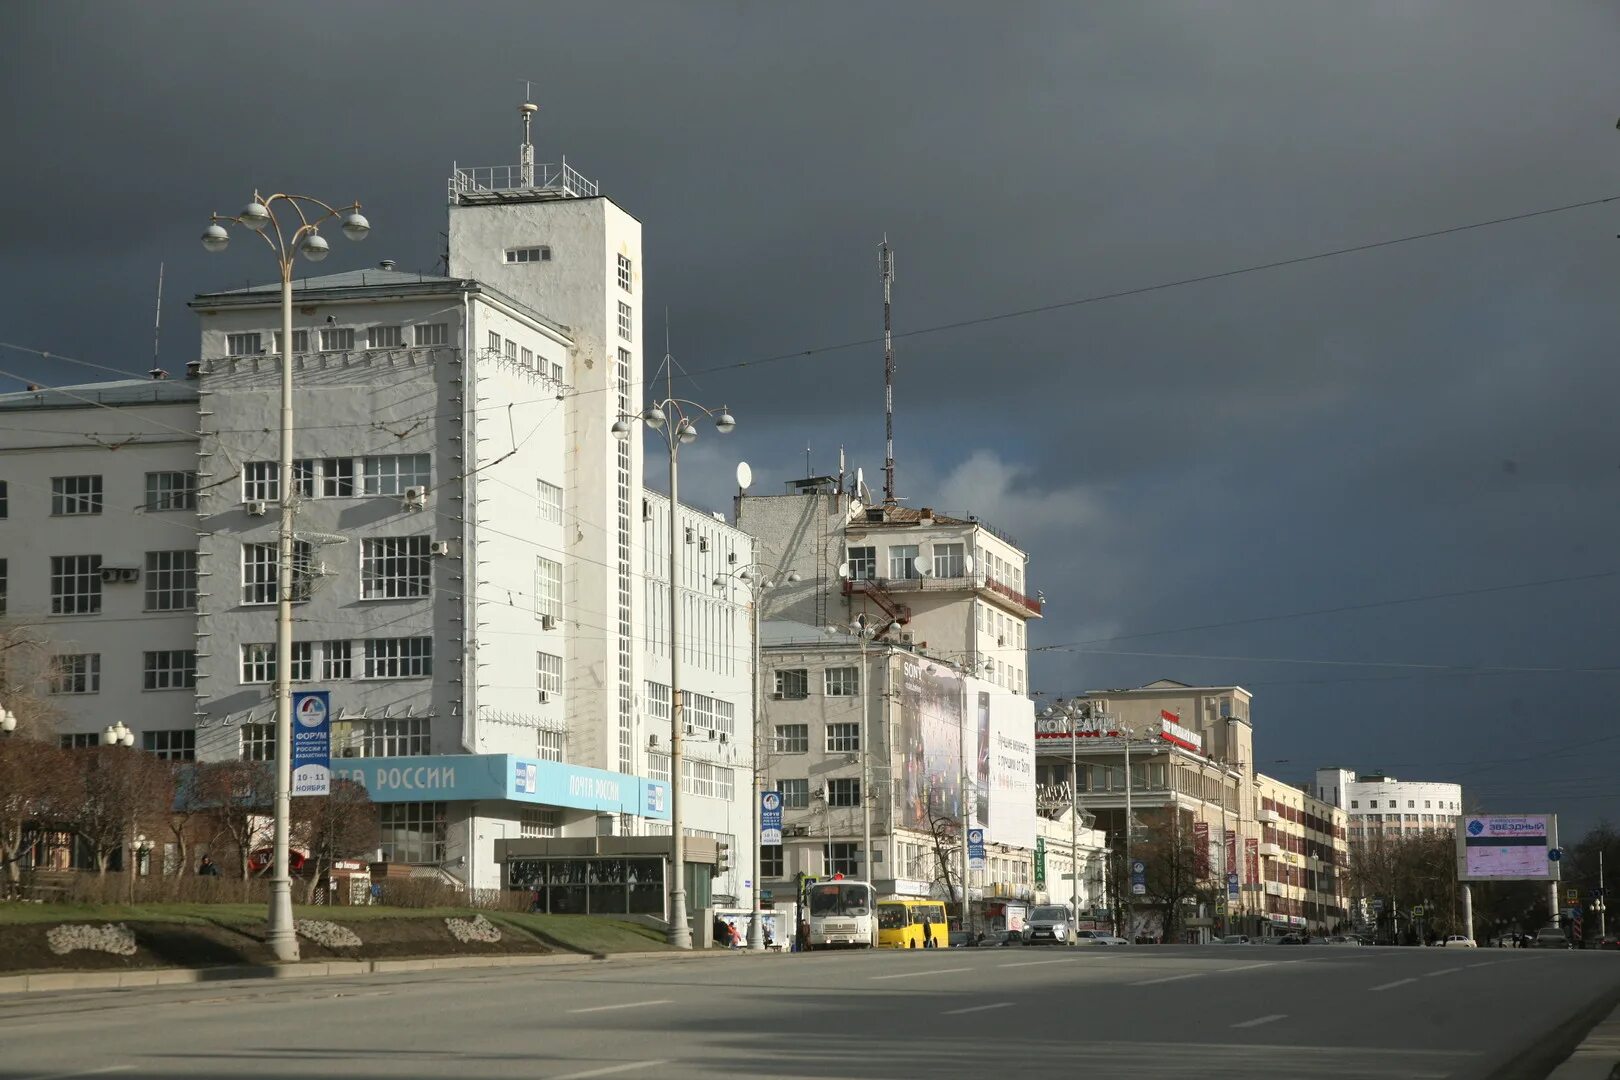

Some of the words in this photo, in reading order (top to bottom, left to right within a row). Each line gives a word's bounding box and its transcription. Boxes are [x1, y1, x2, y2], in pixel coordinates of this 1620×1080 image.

[904, 662, 922, 681] SONY
[296, 732, 327, 740] ФОРУМ
[315, 773, 325, 781] 11
[376, 767, 456, 790] РОССИИ
[295, 784, 326, 792] НОЯБРЯ
[569, 774, 594, 798] ПОЧТА
[595, 778, 620, 801] РОССИИ
